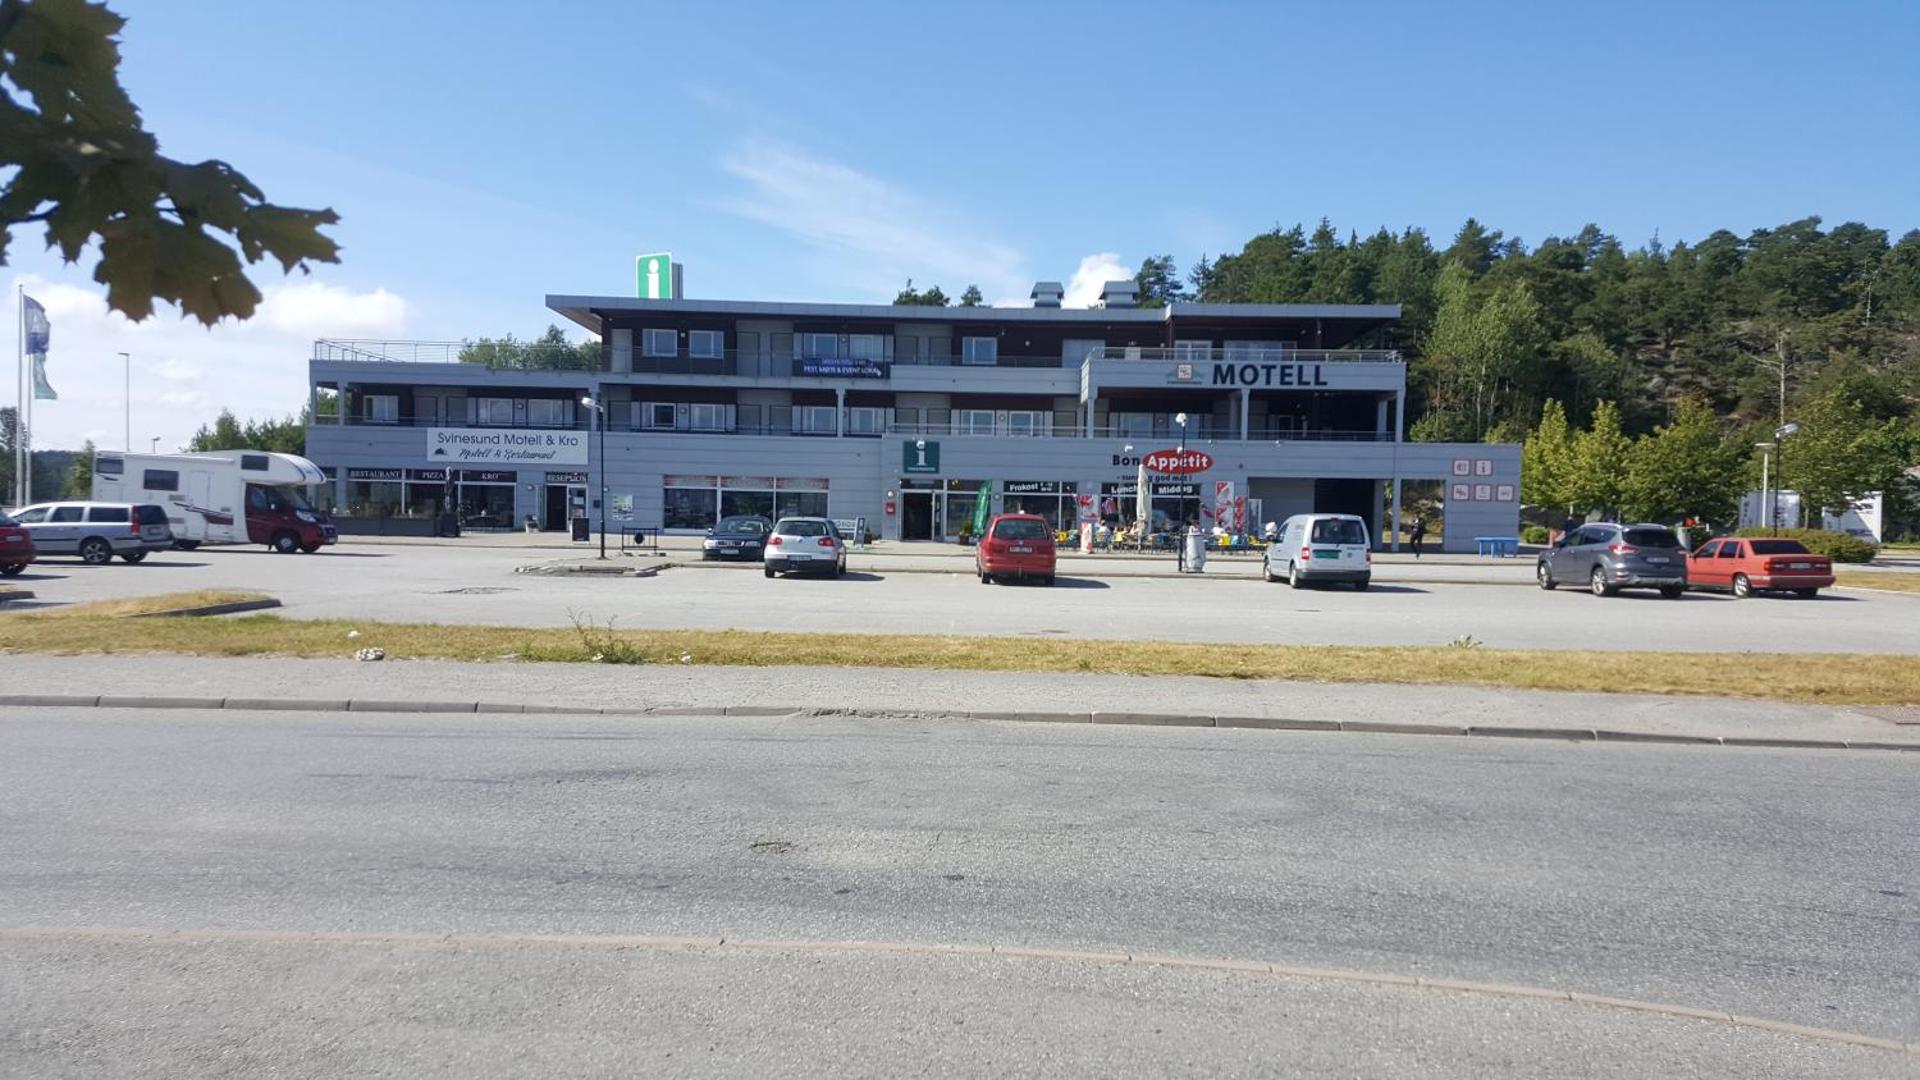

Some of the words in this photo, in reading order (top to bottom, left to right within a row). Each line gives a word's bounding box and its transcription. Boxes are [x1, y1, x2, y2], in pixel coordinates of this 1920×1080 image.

[1212, 363, 1328, 386] MOTELL
[437, 432, 500, 445] Svinesund
[504, 434, 542, 446] Motell
[545, 434, 555, 446] &
[558, 435, 579, 447] Kro
[1112, 454, 1140, 466] Bon
[350, 470, 400, 479] RESTAURANT
[421, 471, 445, 479] PIZZA
[1009, 482, 1038, 492] Frokost
